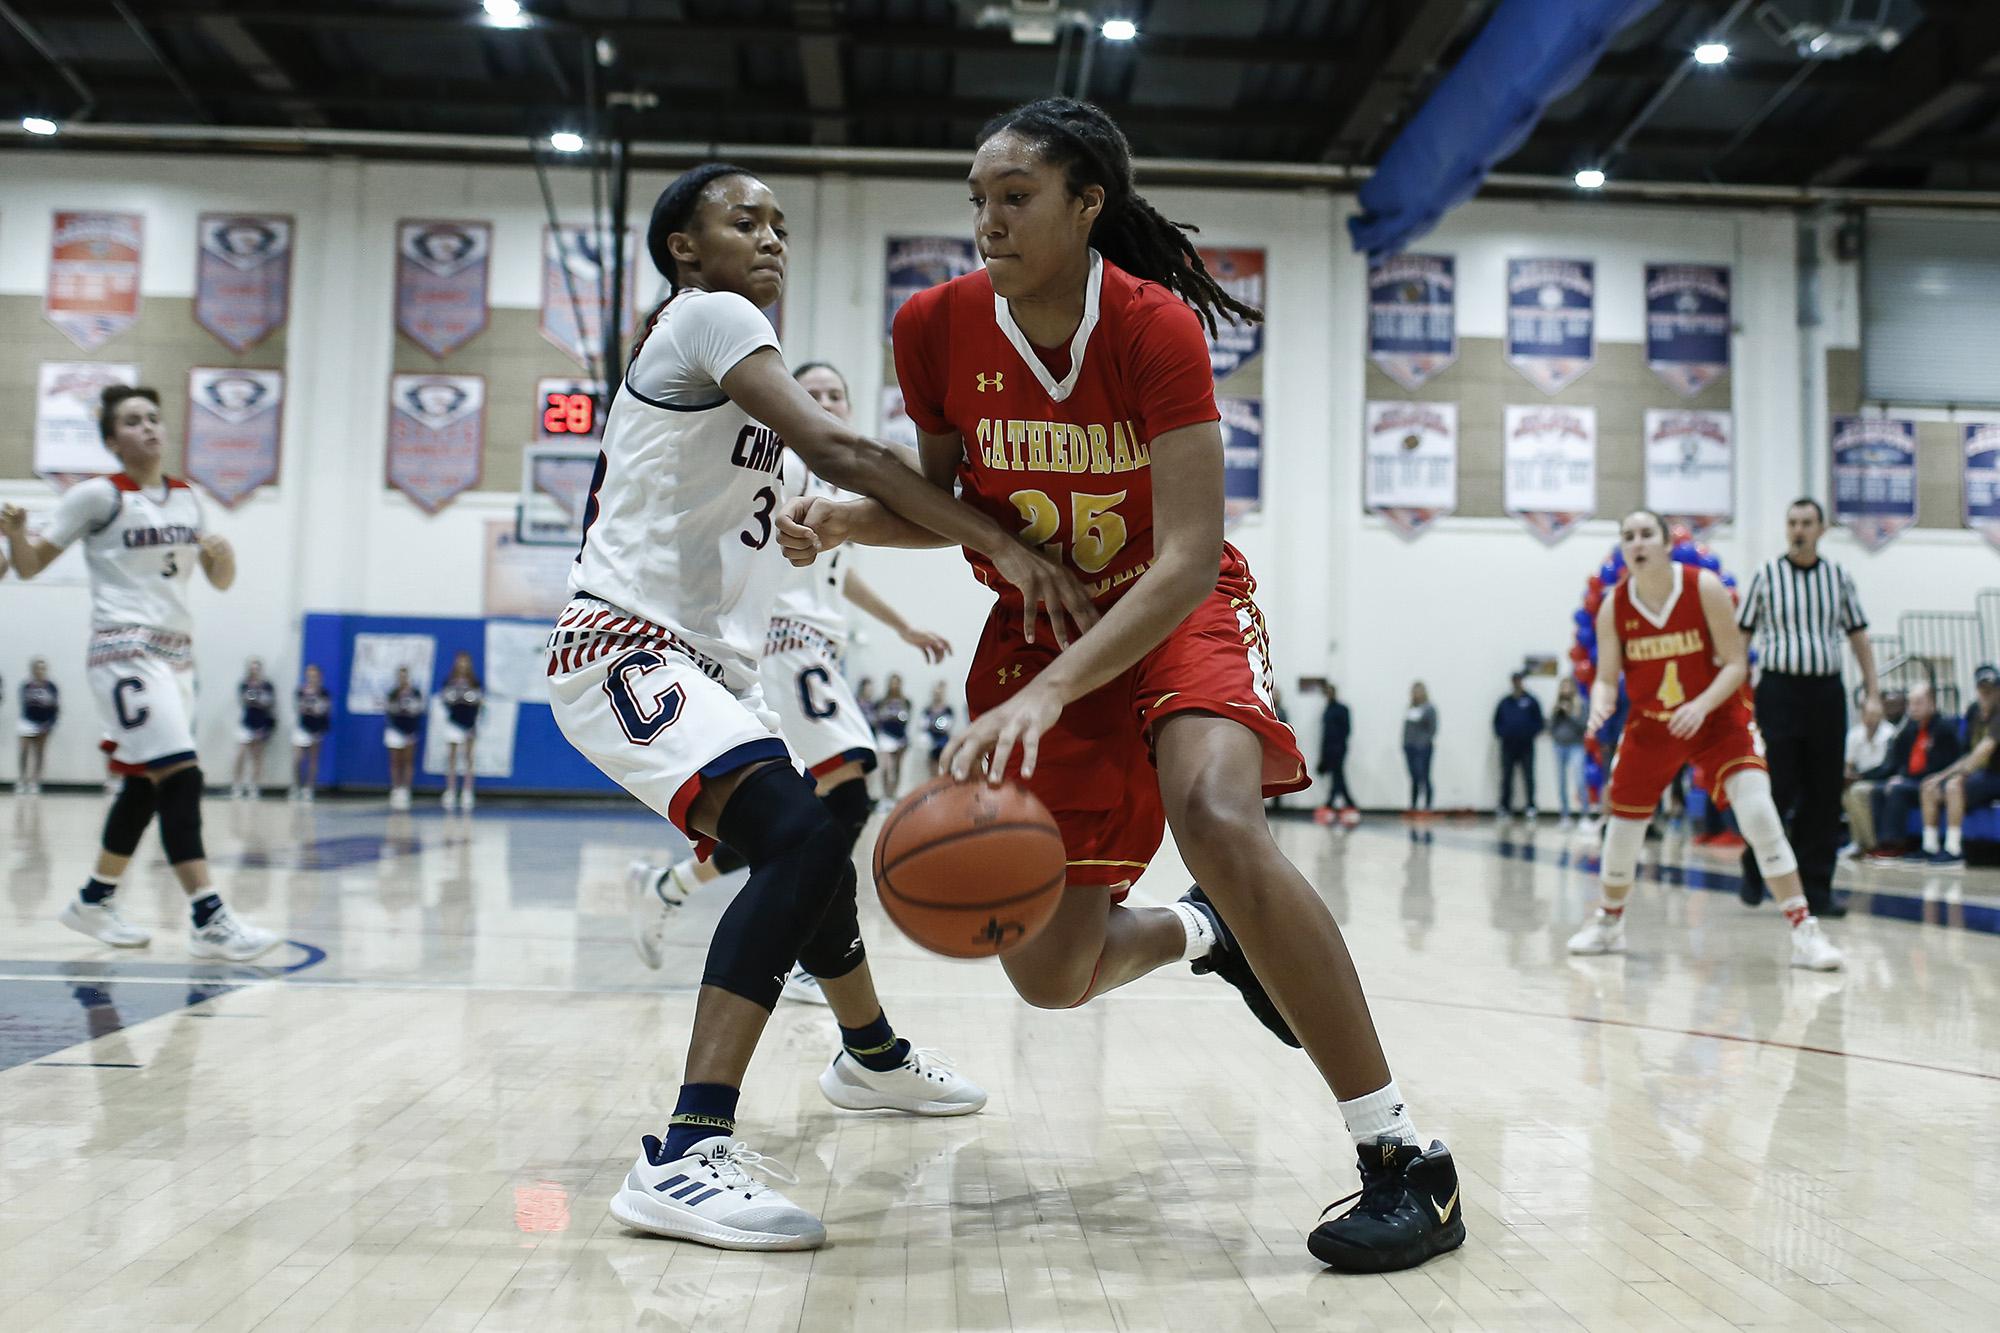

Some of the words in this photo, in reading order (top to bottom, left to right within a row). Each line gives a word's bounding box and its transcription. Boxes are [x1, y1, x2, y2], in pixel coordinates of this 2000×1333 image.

[543, 393, 592, 434] 28
[976, 418, 1151, 474] CATHEDRAL
[1008, 489, 1127, 573] 25
[114, 676, 149, 730] C
[602, 649, 687, 746] C
[798, 665, 838, 719] C
[1656, 660, 1686, 709] 4
